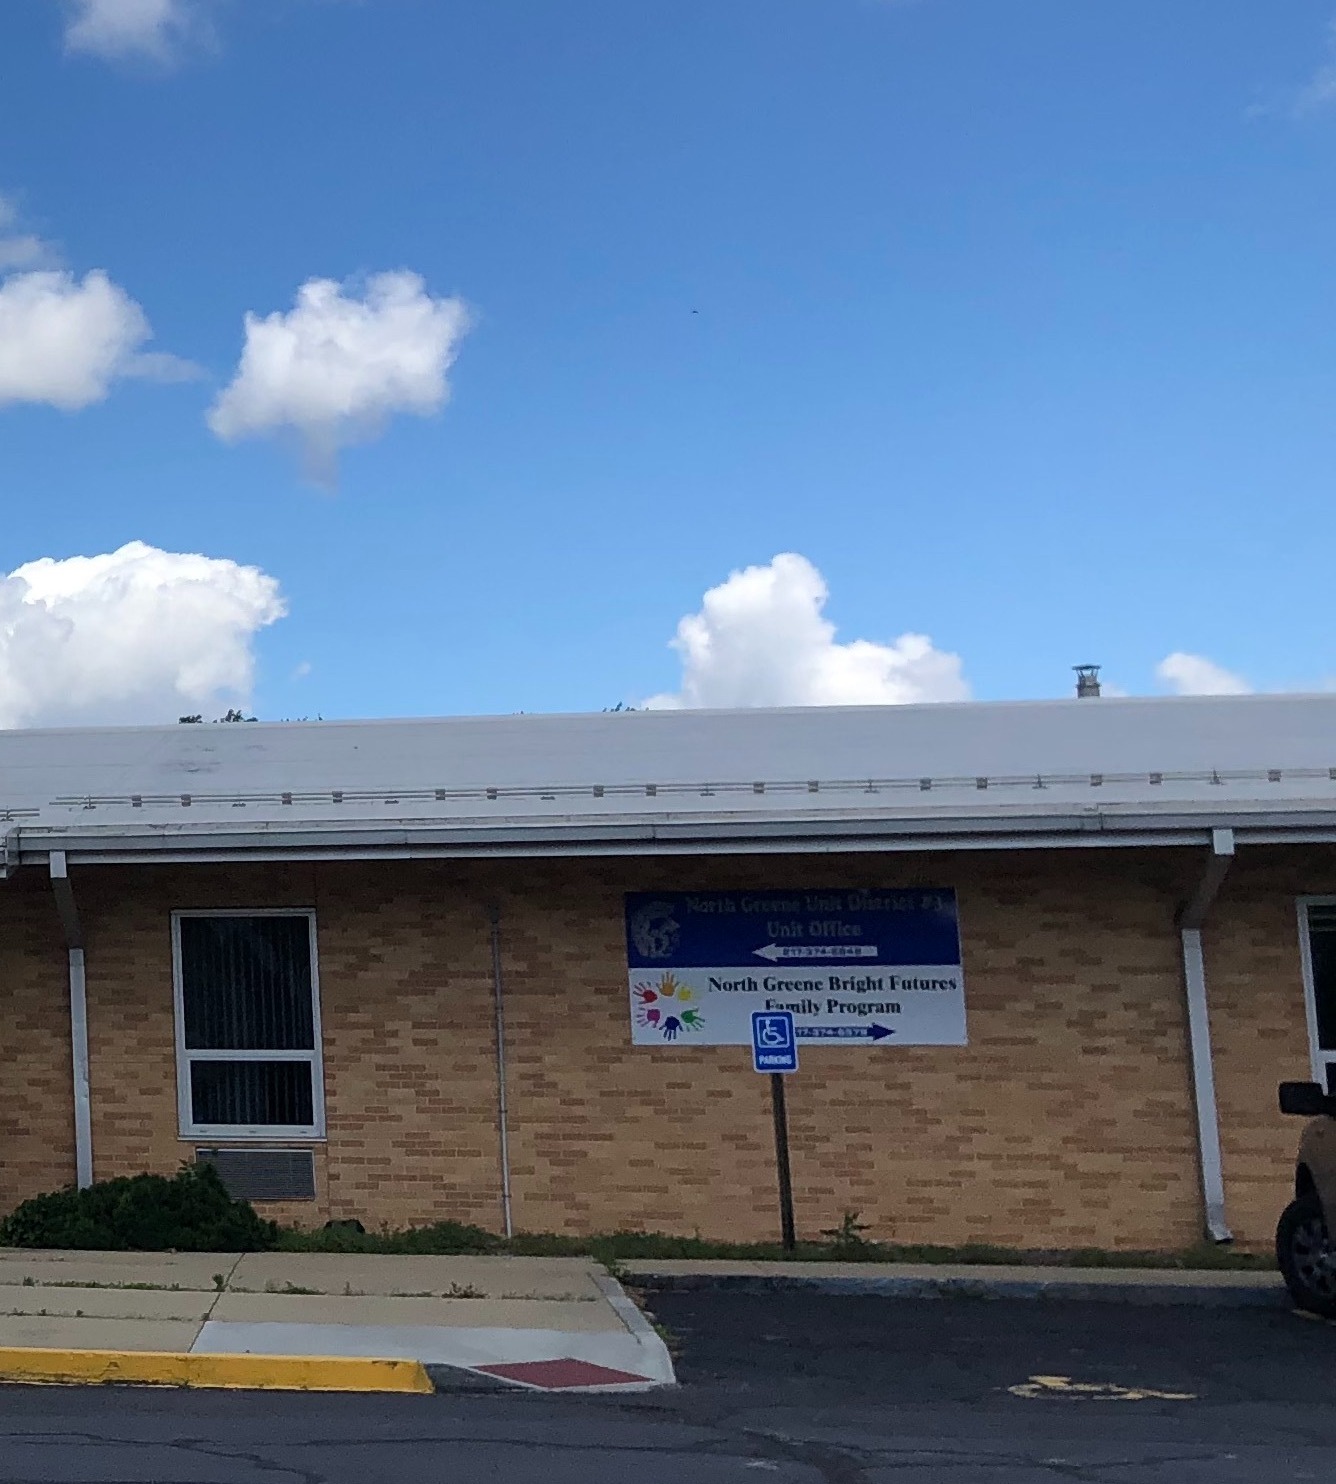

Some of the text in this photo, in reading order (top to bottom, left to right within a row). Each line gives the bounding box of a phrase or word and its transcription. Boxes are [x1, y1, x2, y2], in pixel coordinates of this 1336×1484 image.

[686, 896, 736, 913] North
[740, 895, 801, 913] Greene
[806, 895, 842, 912] Unit
[847, 893, 914, 911] District
[767, 920, 863, 938] Unit Office
[708, 975, 958, 993] North Greene Bright Futures
[765, 999, 902, 1017] Family Program
[758, 1054, 793, 1065] PARKING
